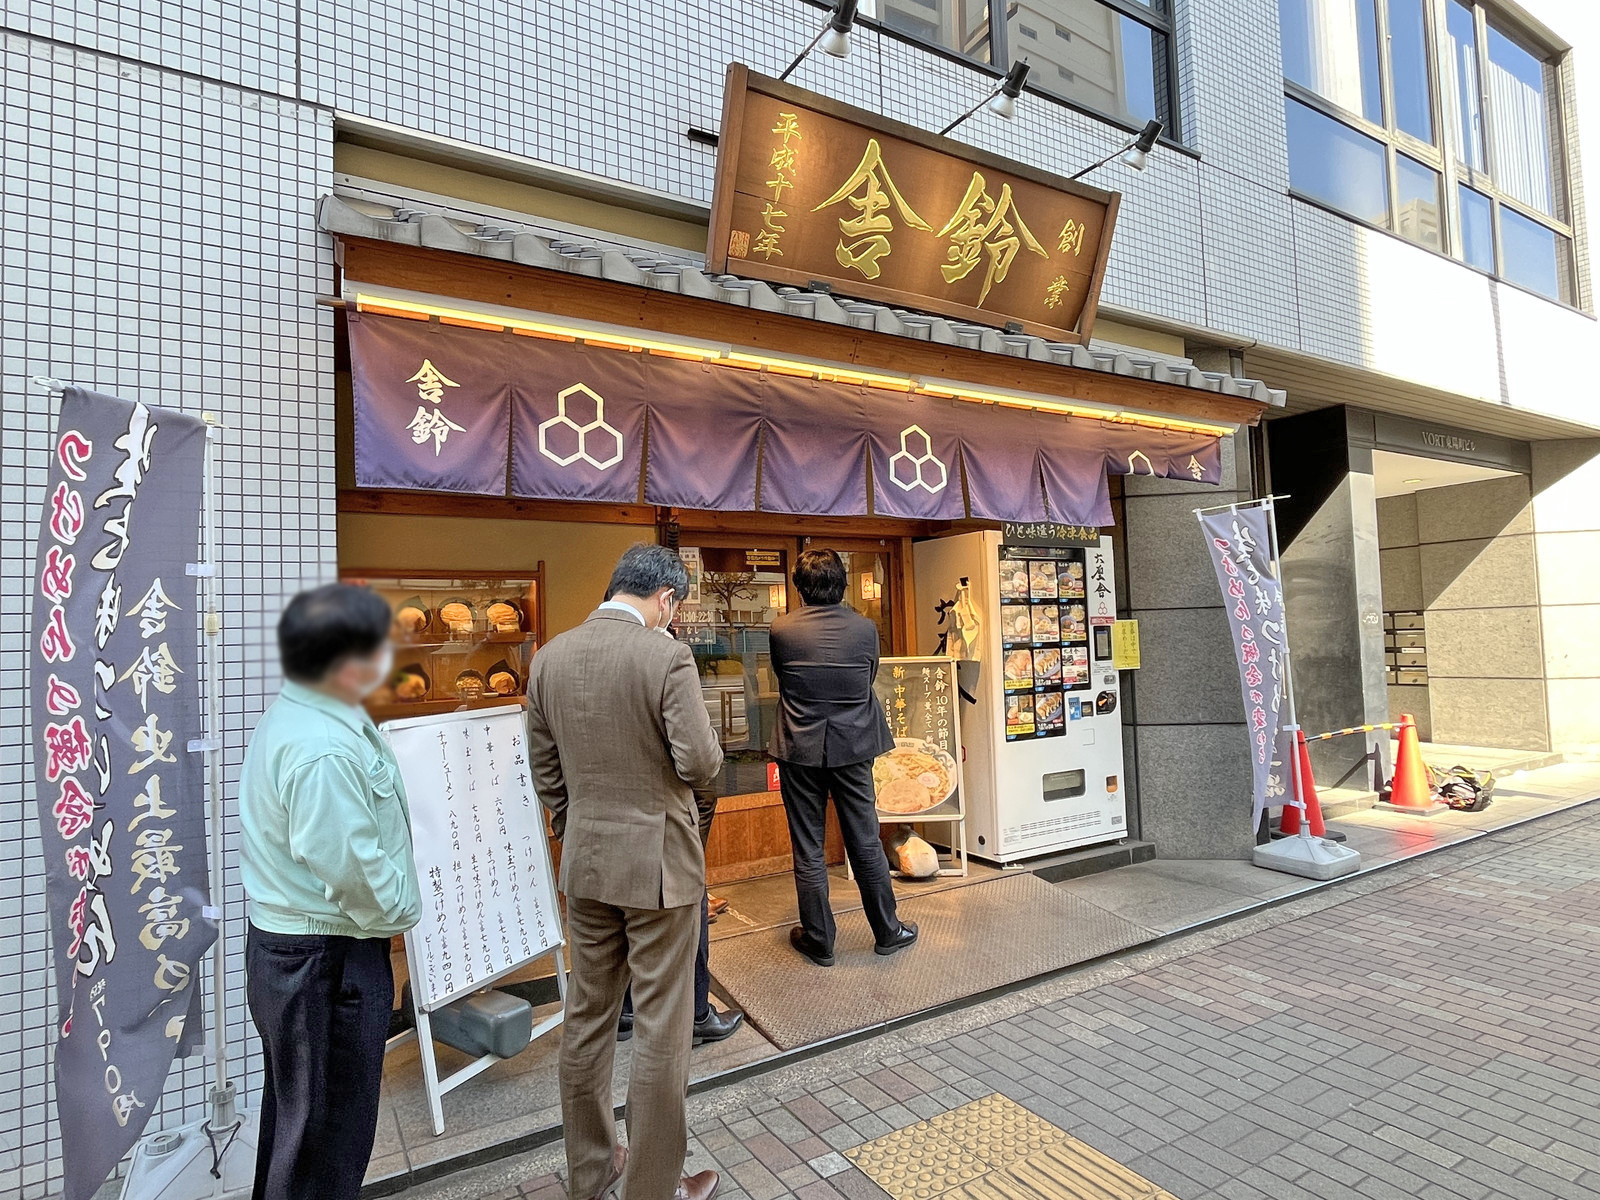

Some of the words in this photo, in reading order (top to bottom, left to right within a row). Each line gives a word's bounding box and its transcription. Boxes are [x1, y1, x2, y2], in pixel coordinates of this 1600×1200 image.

[752, 112, 803, 260] 平成十七年
[810, 138, 1050, 308] 舎鈴
[1043, 218, 1085, 310] 創業
[405, 358, 467, 457] 舎鈴
